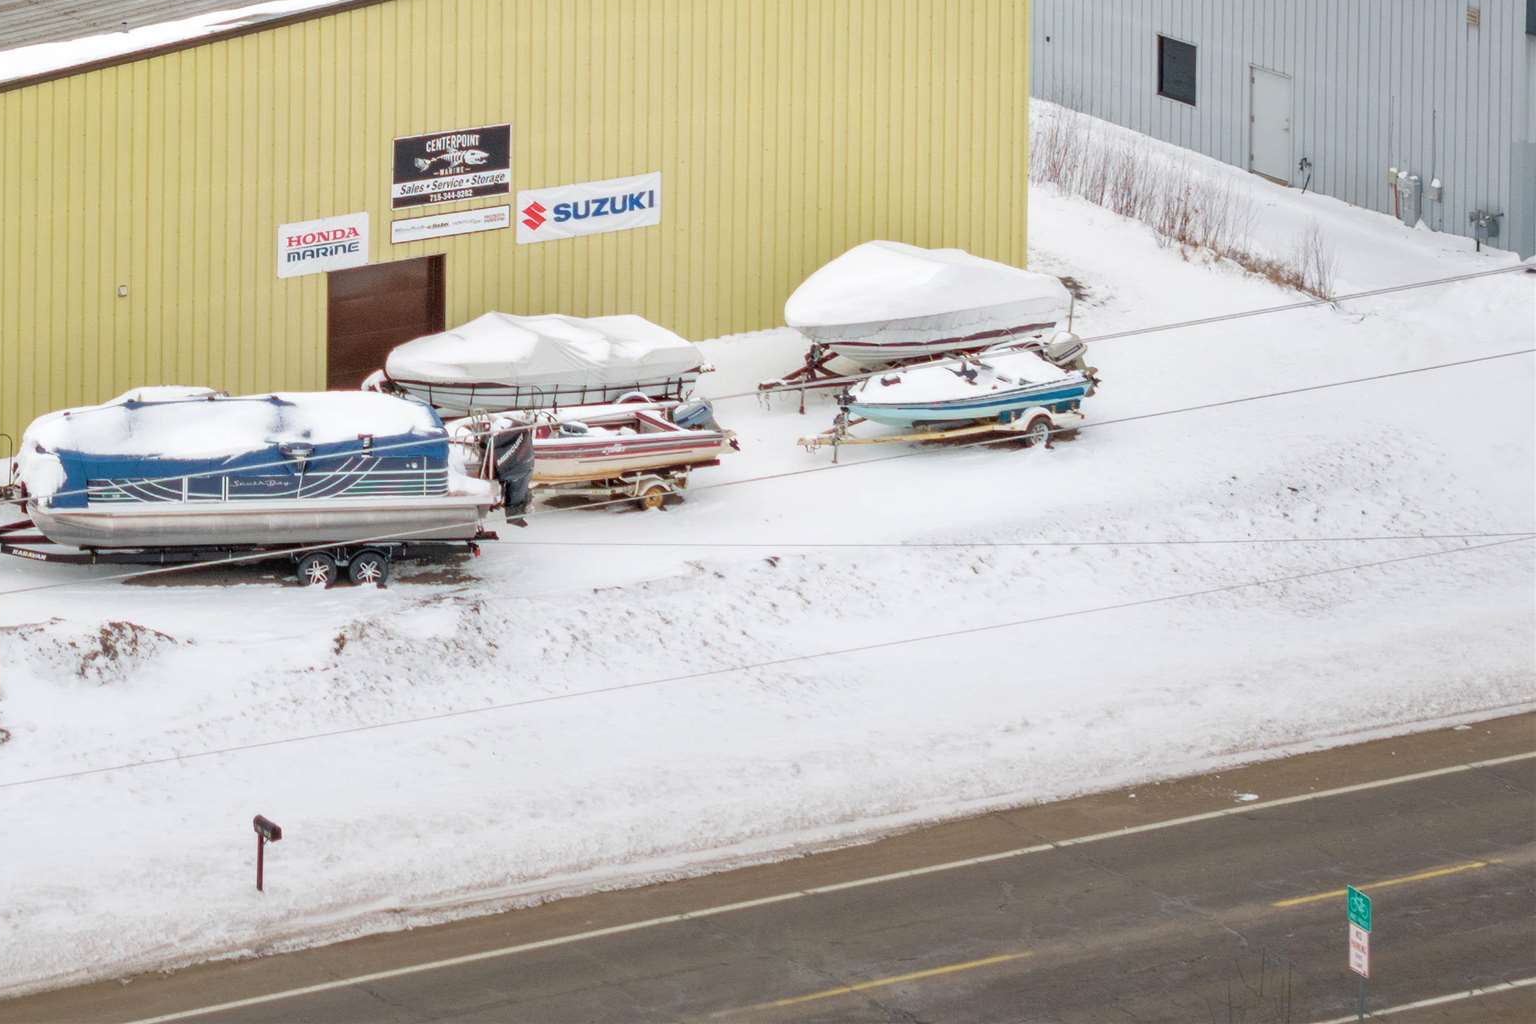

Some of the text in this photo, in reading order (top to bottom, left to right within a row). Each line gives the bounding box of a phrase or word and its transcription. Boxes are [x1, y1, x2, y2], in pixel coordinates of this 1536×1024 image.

[426, 134, 480, 153] CENTERPOINT
[400, 172, 506, 195] Sales Service Storage
[553, 189, 654, 223] SUZUKI
[287, 227, 360, 248] HONDA
